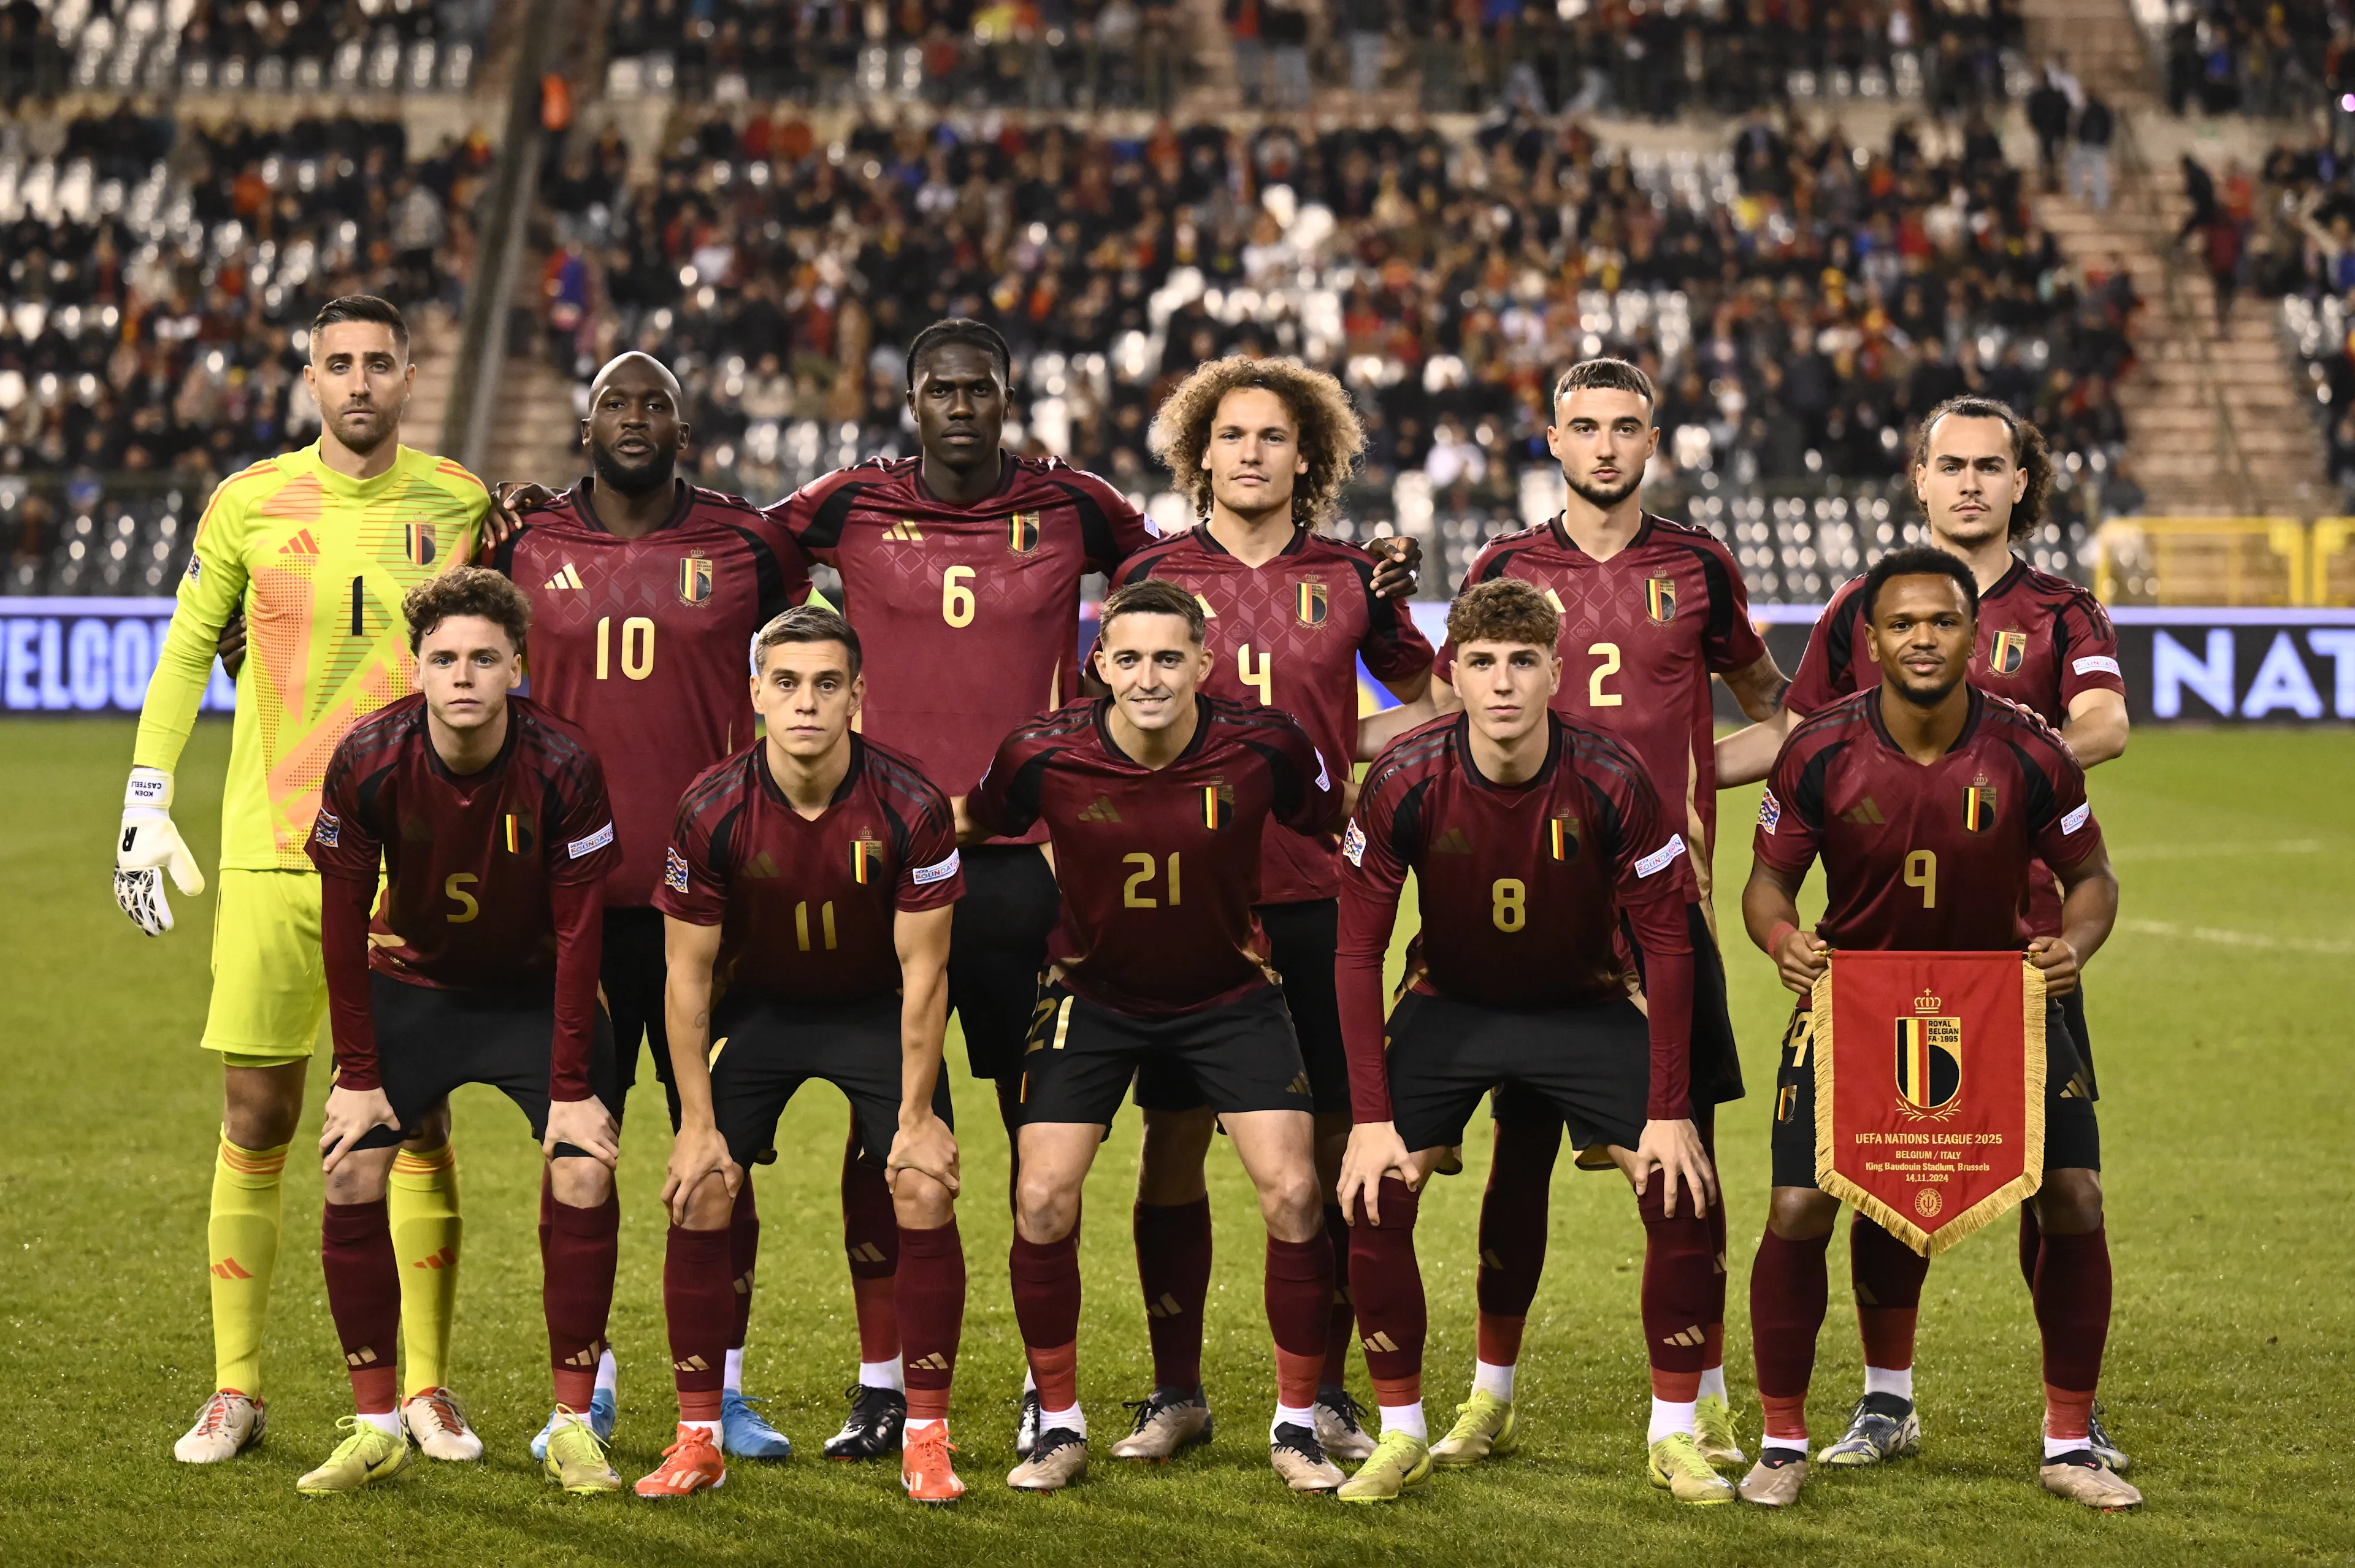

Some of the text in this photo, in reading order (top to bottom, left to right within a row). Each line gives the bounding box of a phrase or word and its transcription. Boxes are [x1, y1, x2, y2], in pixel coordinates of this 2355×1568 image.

[352, 576, 362, 635] 1
[943, 566, 975, 627] 6
[597, 617, 654, 679] 10
[1238, 644, 1271, 705] 4
[1588, 643, 1622, 706] 2
[2153, 627, 2355, 719] NAT
[131, 781, 161, 789] CASTEELS
[446, 873, 478, 922] 5
[1122, 852, 1181, 908] 21
[1492, 878, 1526, 933] 8
[1904, 850, 1937, 908] 9
[795, 901, 837, 951] 11
[1024, 995, 1074, 1056] 21
[1788, 1011, 1813, 1067] 9
[1855, 1133, 2002, 1144] UEFA NATIONS LEAGUE 2025
[1896, 1150, 1961, 1160] BELGIUM / ITALY
[1866, 1162, 1883, 1172] King
[1885, 1162, 1921, 1171] Baudouin
[1958, 1163, 1990, 1171] Brussels
[1905, 1174, 1949, 1183] 14.11.2024
